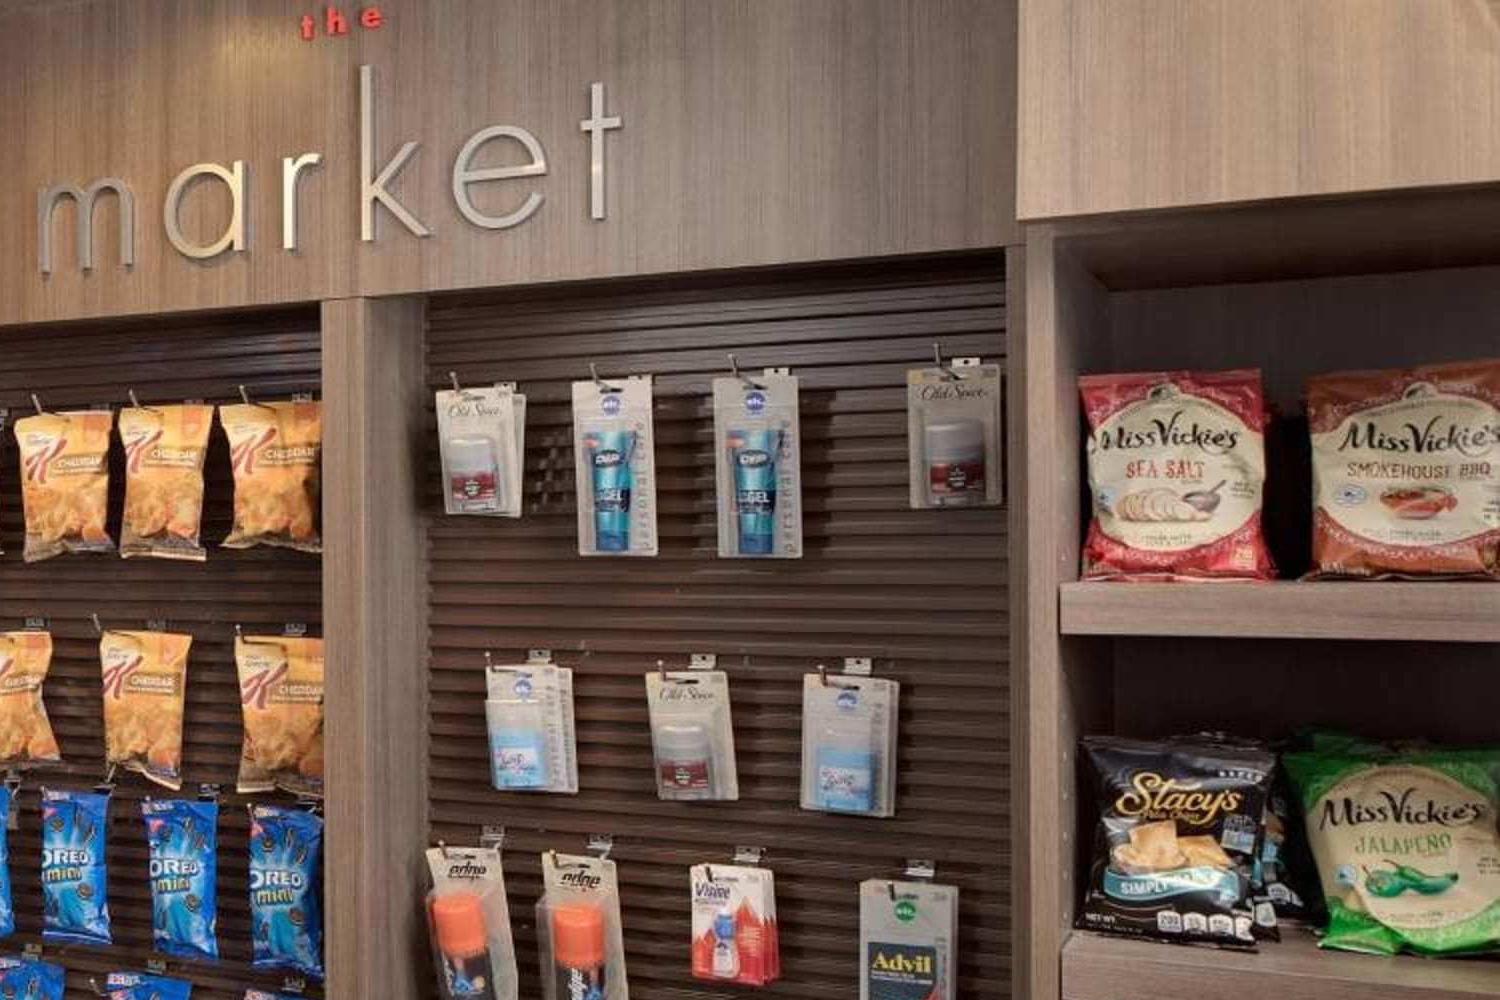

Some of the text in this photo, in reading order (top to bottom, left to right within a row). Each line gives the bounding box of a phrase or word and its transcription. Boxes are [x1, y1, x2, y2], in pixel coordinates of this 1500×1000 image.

[301, 4, 383, 41] the
[36, 63, 623, 274] market
[1152, 410, 1238, 452] Vickie's
[1338, 421, 1409, 453] Miss
[1126, 460, 1205, 481] SEA SALT
[1347, 461, 1491, 480] SMOKEHOUSE BBQ
[1115, 771, 1242, 826] Stacy's
[1320, 787, 1486, 831] Miss Vickie's
[150, 858, 198, 878] OREO
[249, 868, 302, 889] OREO
[694, 881, 731, 899] Visine
[1120, 879, 1168, 895] SIMPLY
[872, 951, 932, 973] Advil
